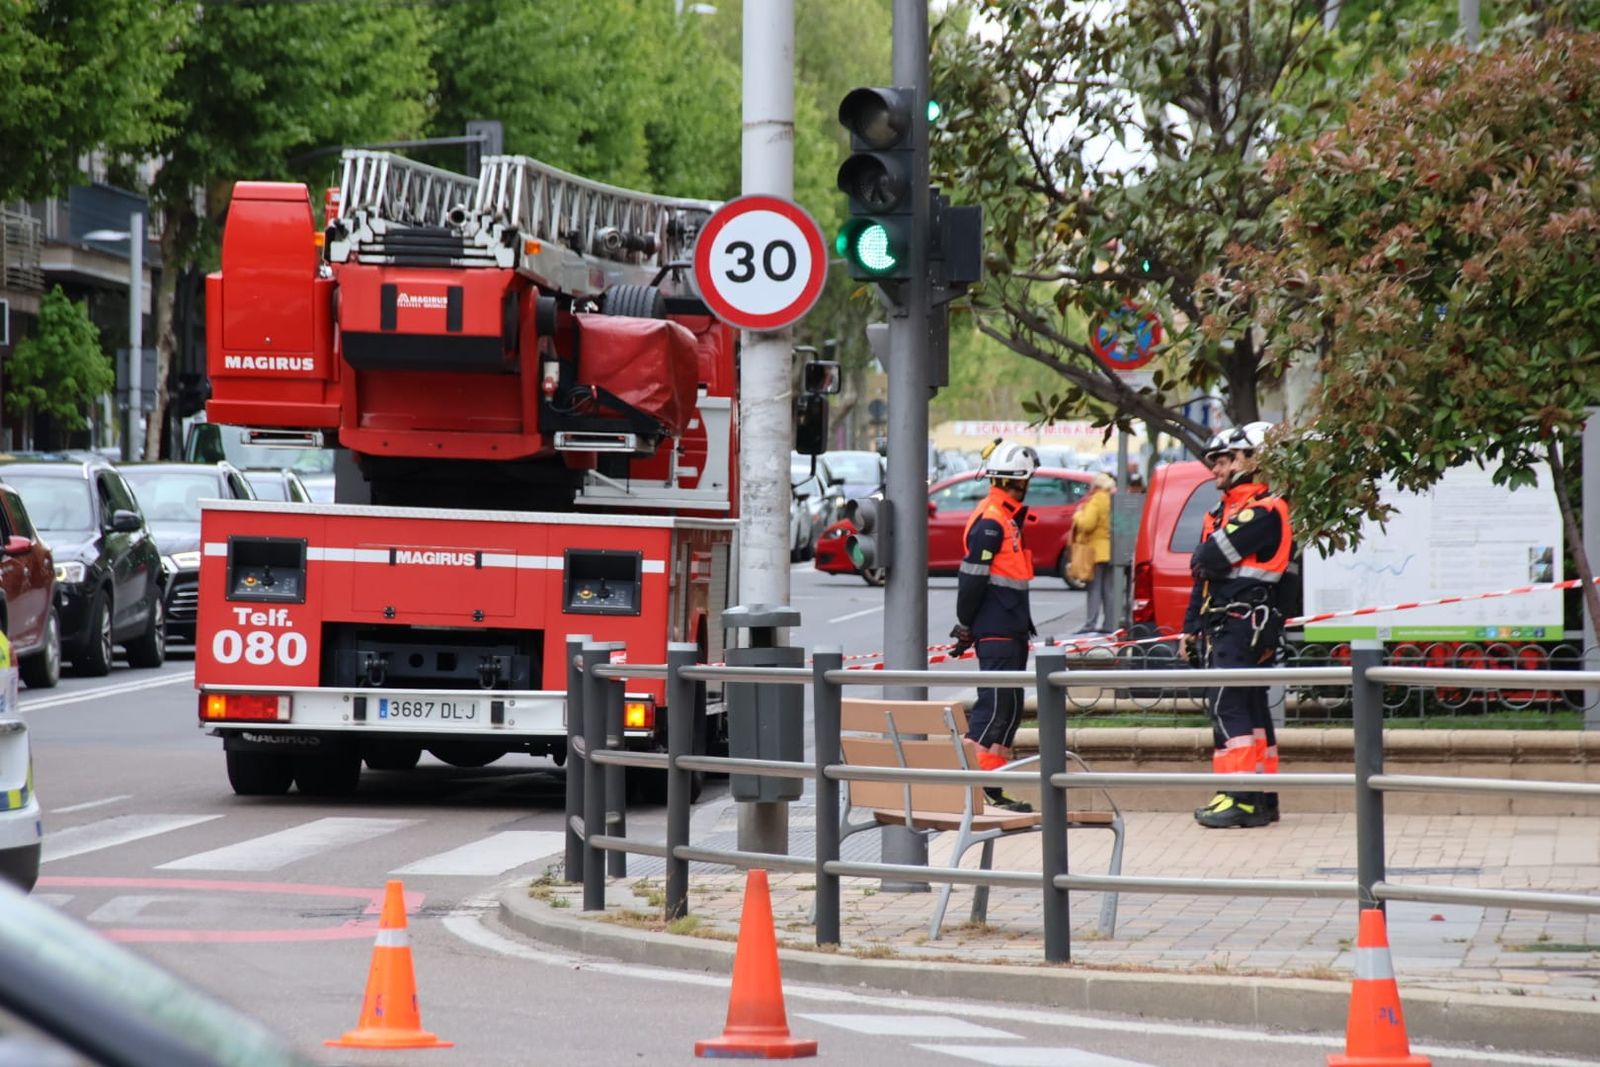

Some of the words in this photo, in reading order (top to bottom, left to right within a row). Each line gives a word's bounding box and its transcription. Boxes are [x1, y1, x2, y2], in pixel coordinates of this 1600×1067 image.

[725, 240, 797, 283] 30
[409, 296, 448, 304] MAGIRUS
[224, 355, 315, 371] MAGIRUS
[396, 550, 476, 567] MAGIRUS
[232, 607, 293, 627] Telf.
[212, 629, 308, 667] 080
[390, 701, 435, 719] 3687
[441, 702, 475, 720] DLJ
